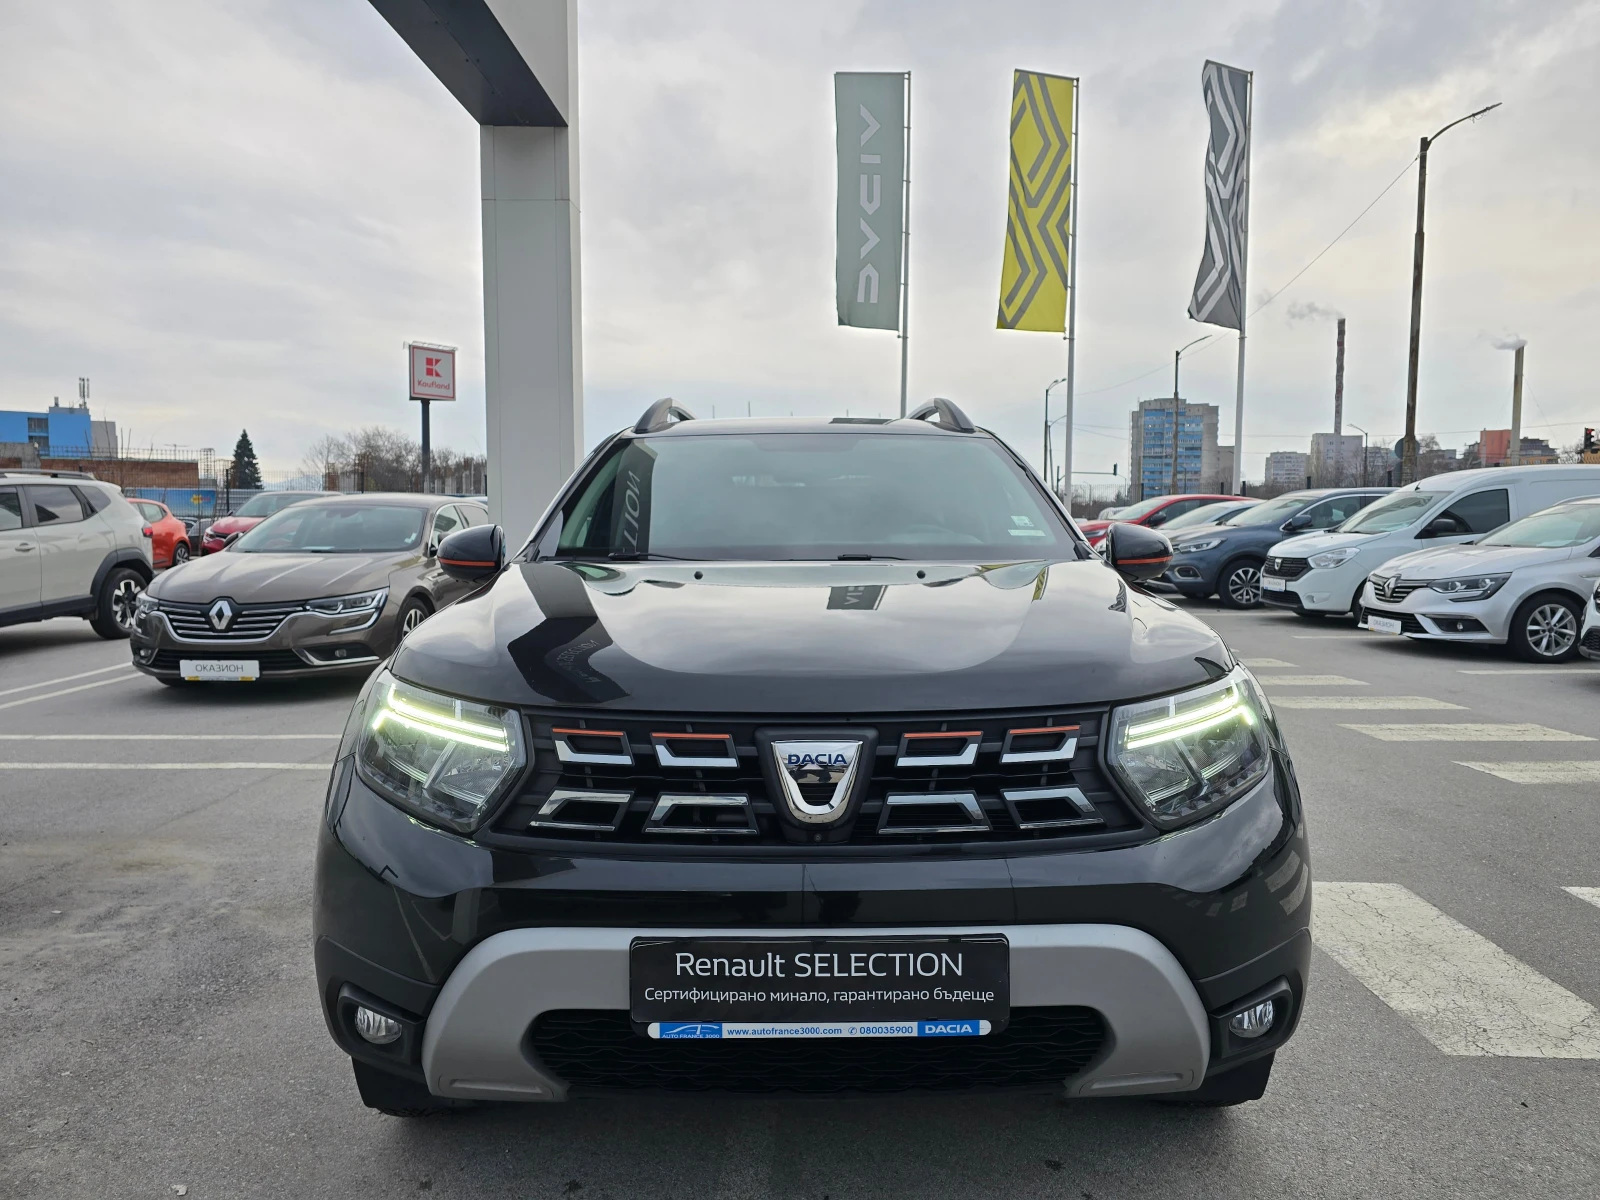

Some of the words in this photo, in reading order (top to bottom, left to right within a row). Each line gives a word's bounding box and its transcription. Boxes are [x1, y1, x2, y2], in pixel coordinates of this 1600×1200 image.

[417, 379, 450, 390] Kaufland
[195, 664, 244, 673] ОКАЗИОН
[787, 753, 848, 765] DACIA
[675, 952, 786, 978] Renault
[794, 952, 963, 978] SELECTION
[644, 987, 767, 1004] Сертифицирано
[770, 991, 830, 1003] минало,
[833, 990, 931, 1004] гарантирано
[933, 987, 995, 1003] бъдеще
[727, 1026, 843, 1037] www.autofrance3000.com
[859, 1026, 914, 1035] 080035900
[924, 1024, 973, 1034] DACIA
